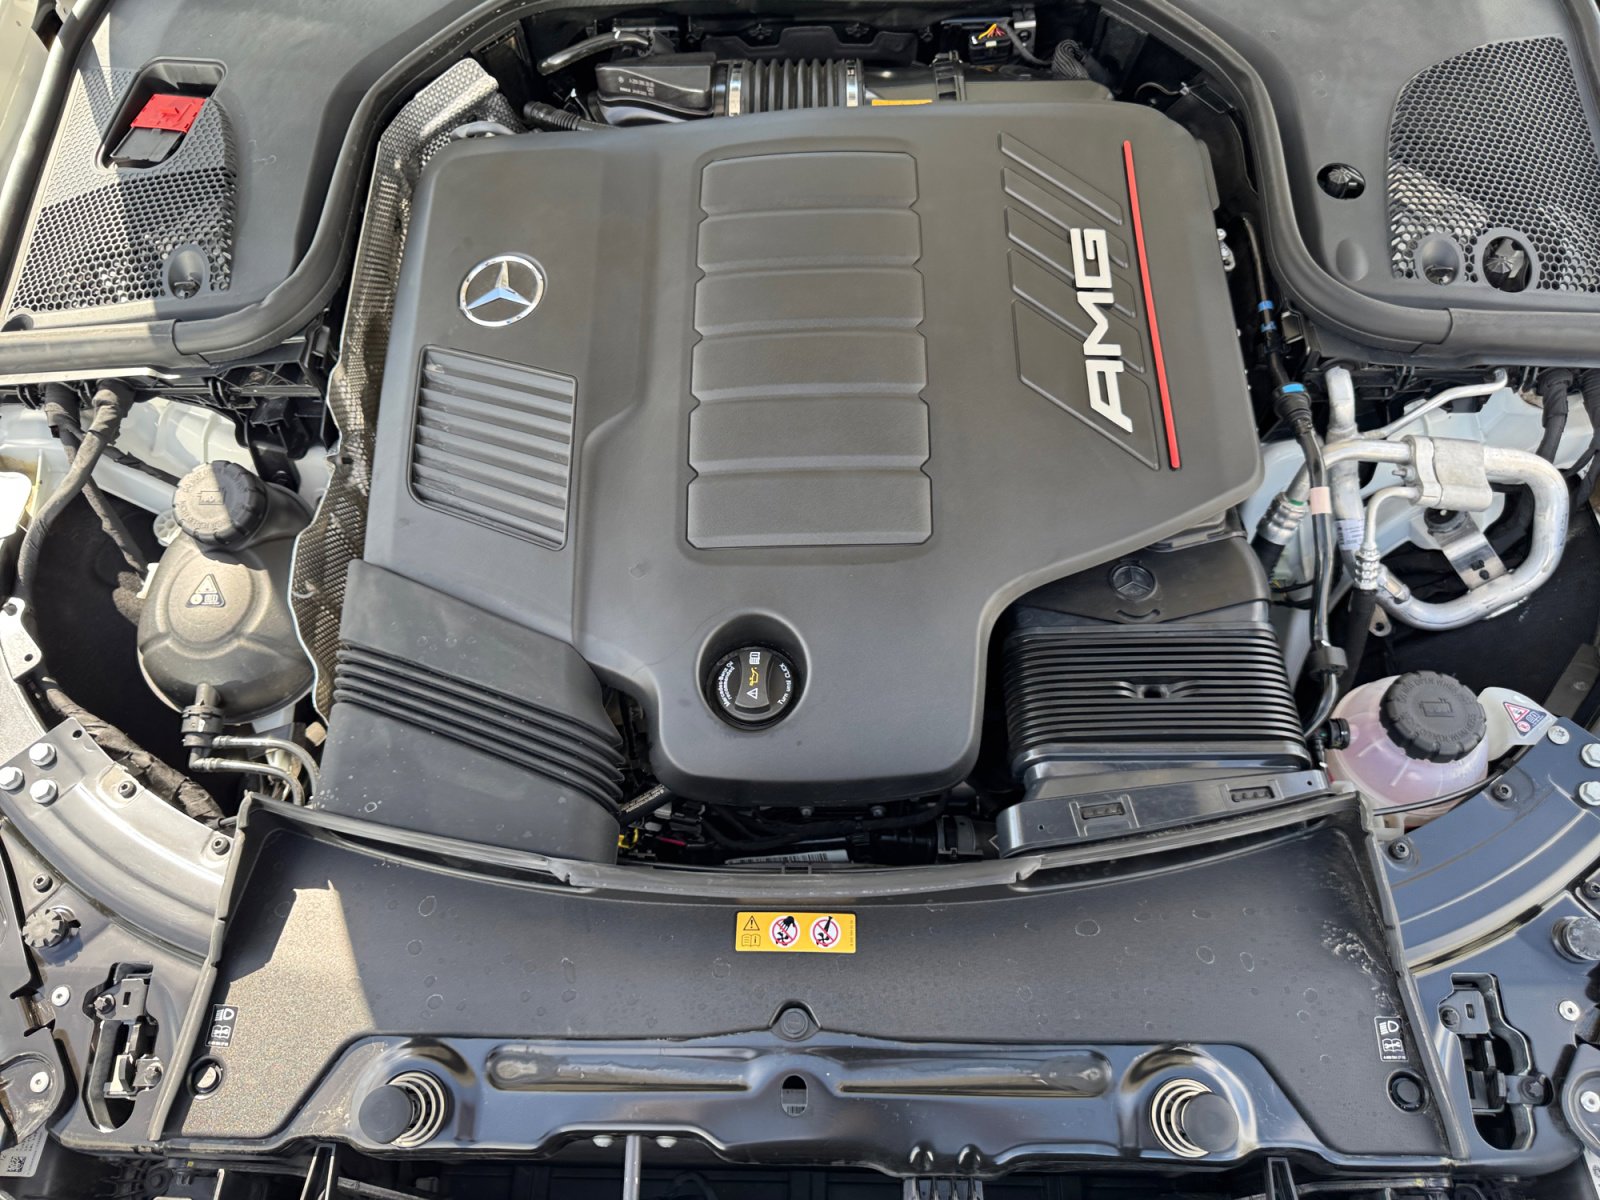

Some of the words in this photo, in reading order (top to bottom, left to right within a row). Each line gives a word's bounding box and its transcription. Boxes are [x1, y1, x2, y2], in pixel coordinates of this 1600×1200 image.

[1069, 227, 1134, 433] AMG
[723, 667, 735, 700] recommended
[779, 663, 791, 678] CLICK
[718, 668, 731, 707] Mercedes-Benz
[777, 693, 788, 705] Turn
